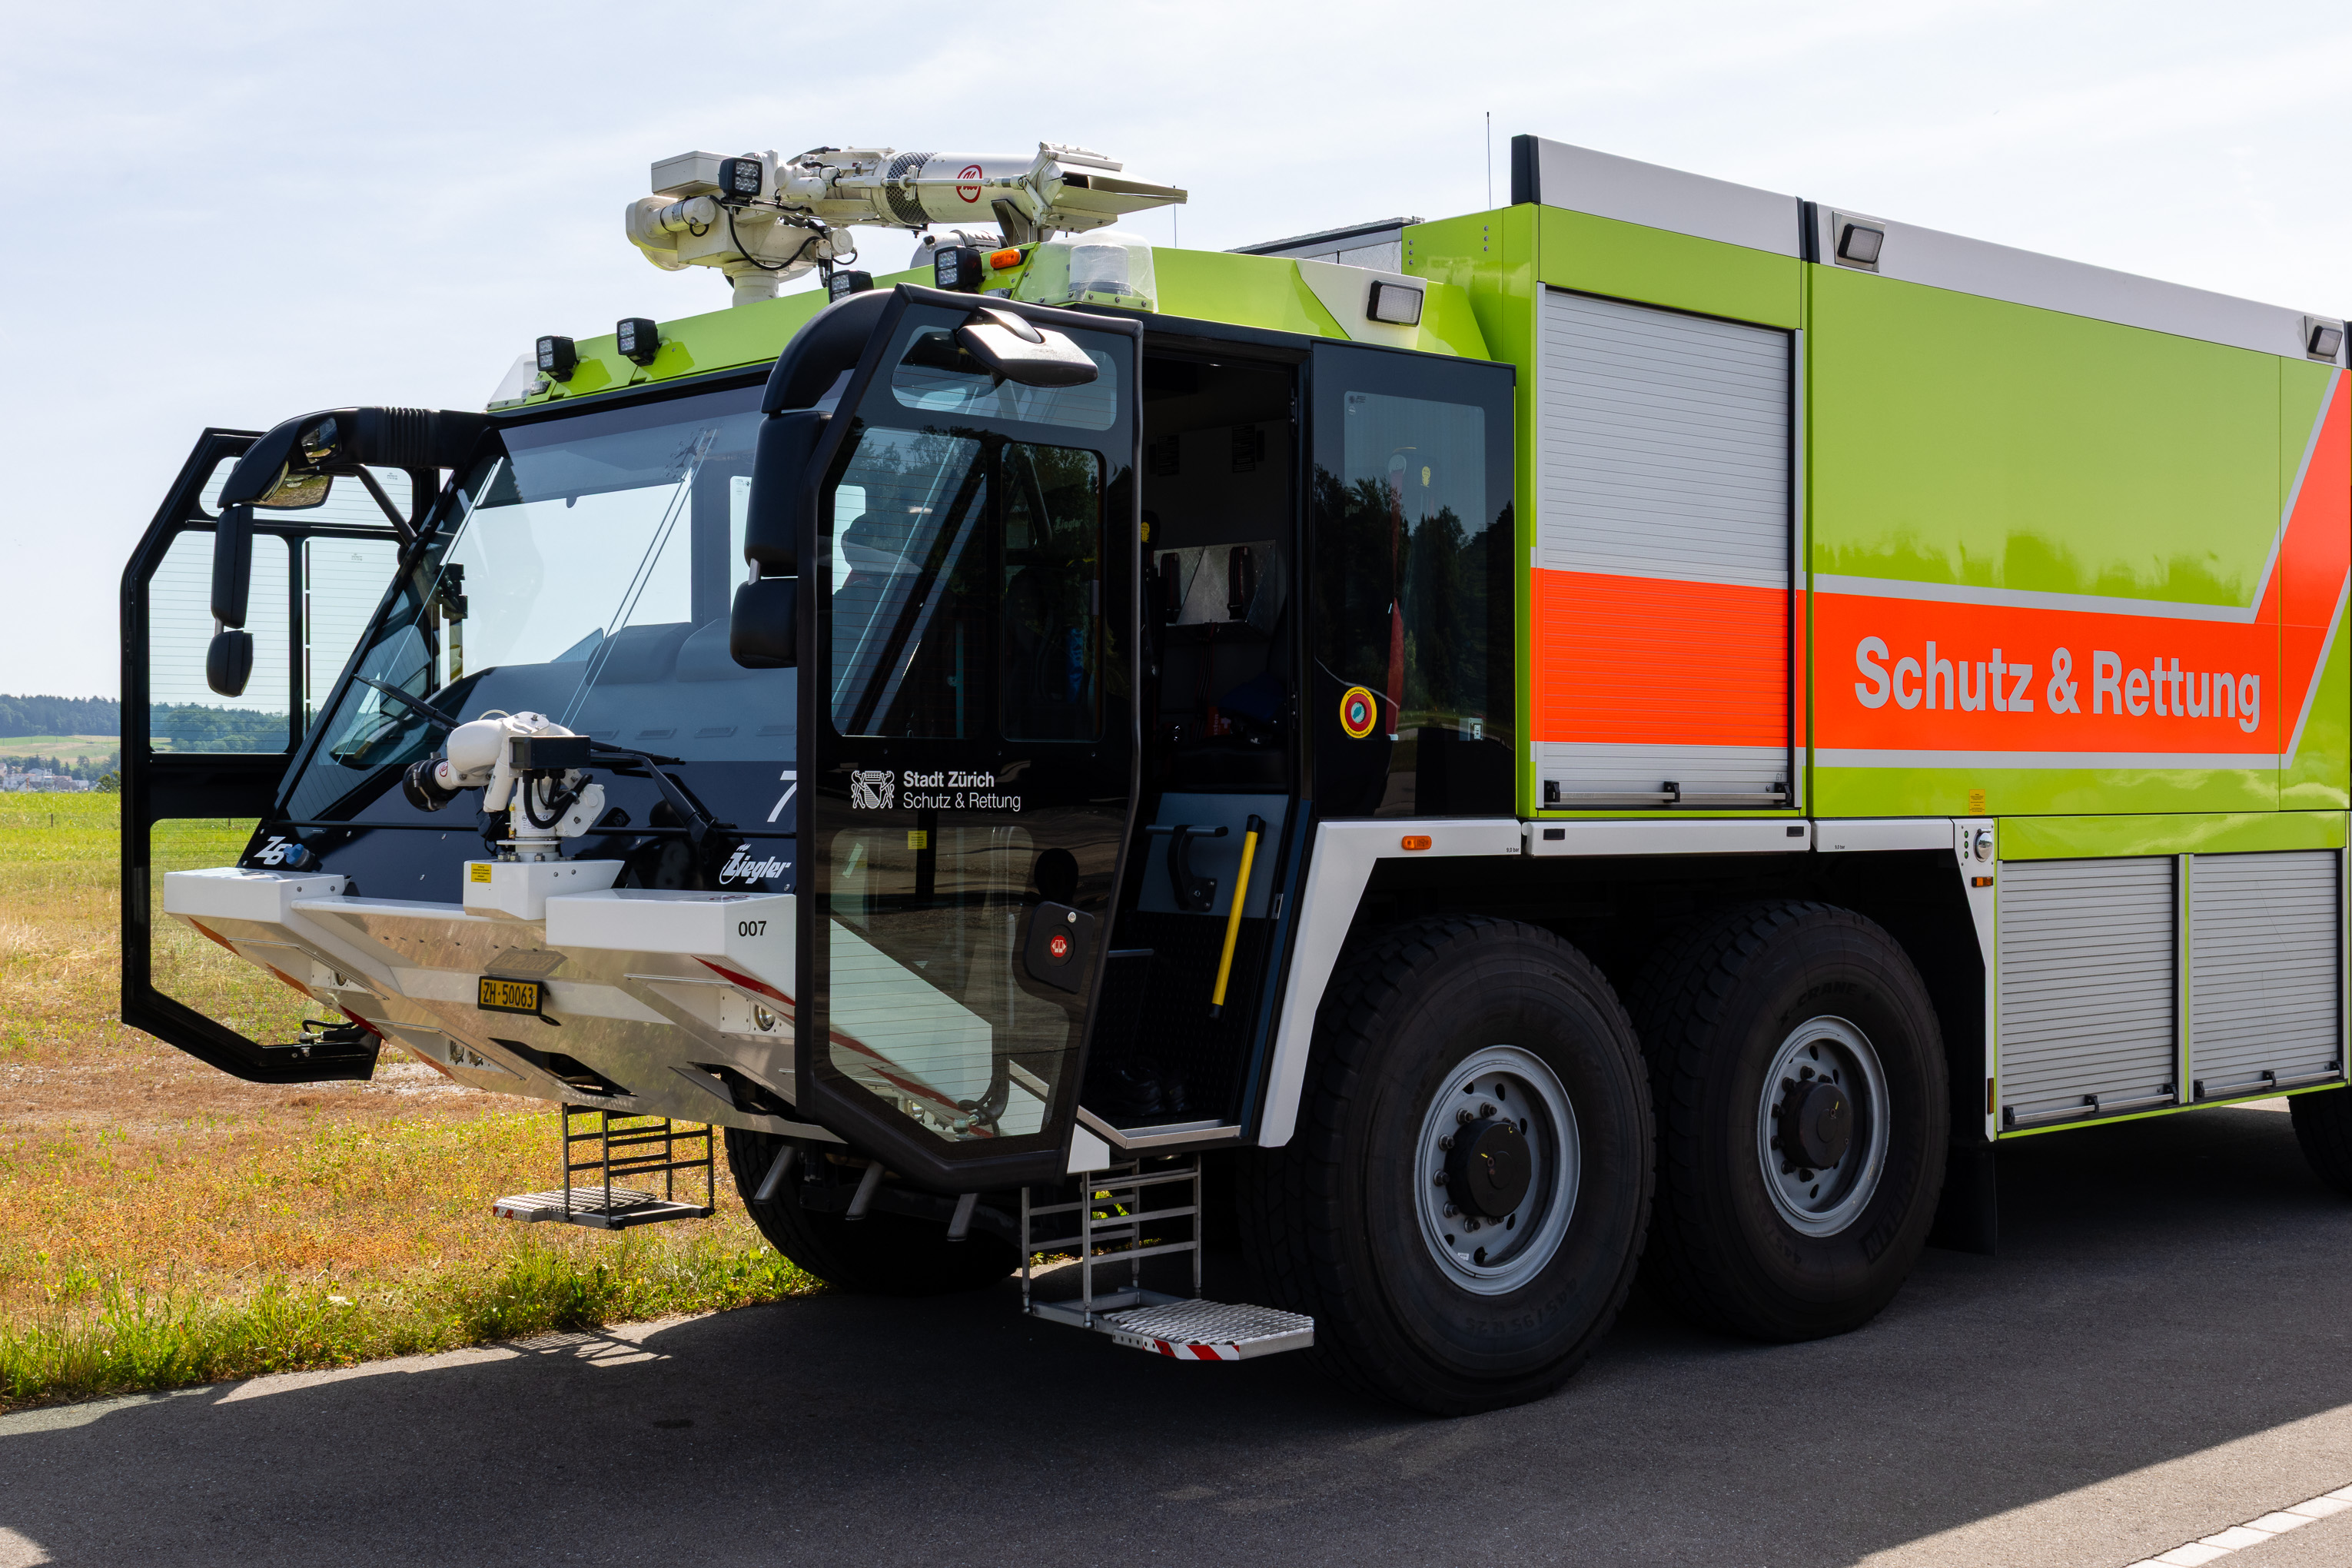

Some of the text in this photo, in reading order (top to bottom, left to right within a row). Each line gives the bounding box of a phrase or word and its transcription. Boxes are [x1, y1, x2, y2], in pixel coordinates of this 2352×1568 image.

[1855, 636, 2261, 733] Schutz & Rettung
[903, 771, 995, 787] Stadt Zürich
[903, 792, 1021, 812] Schutz & Rettung
[254, 836, 293, 865] Z6
[719, 845, 792, 885] Ziegler
[739, 921, 767, 937] 007
